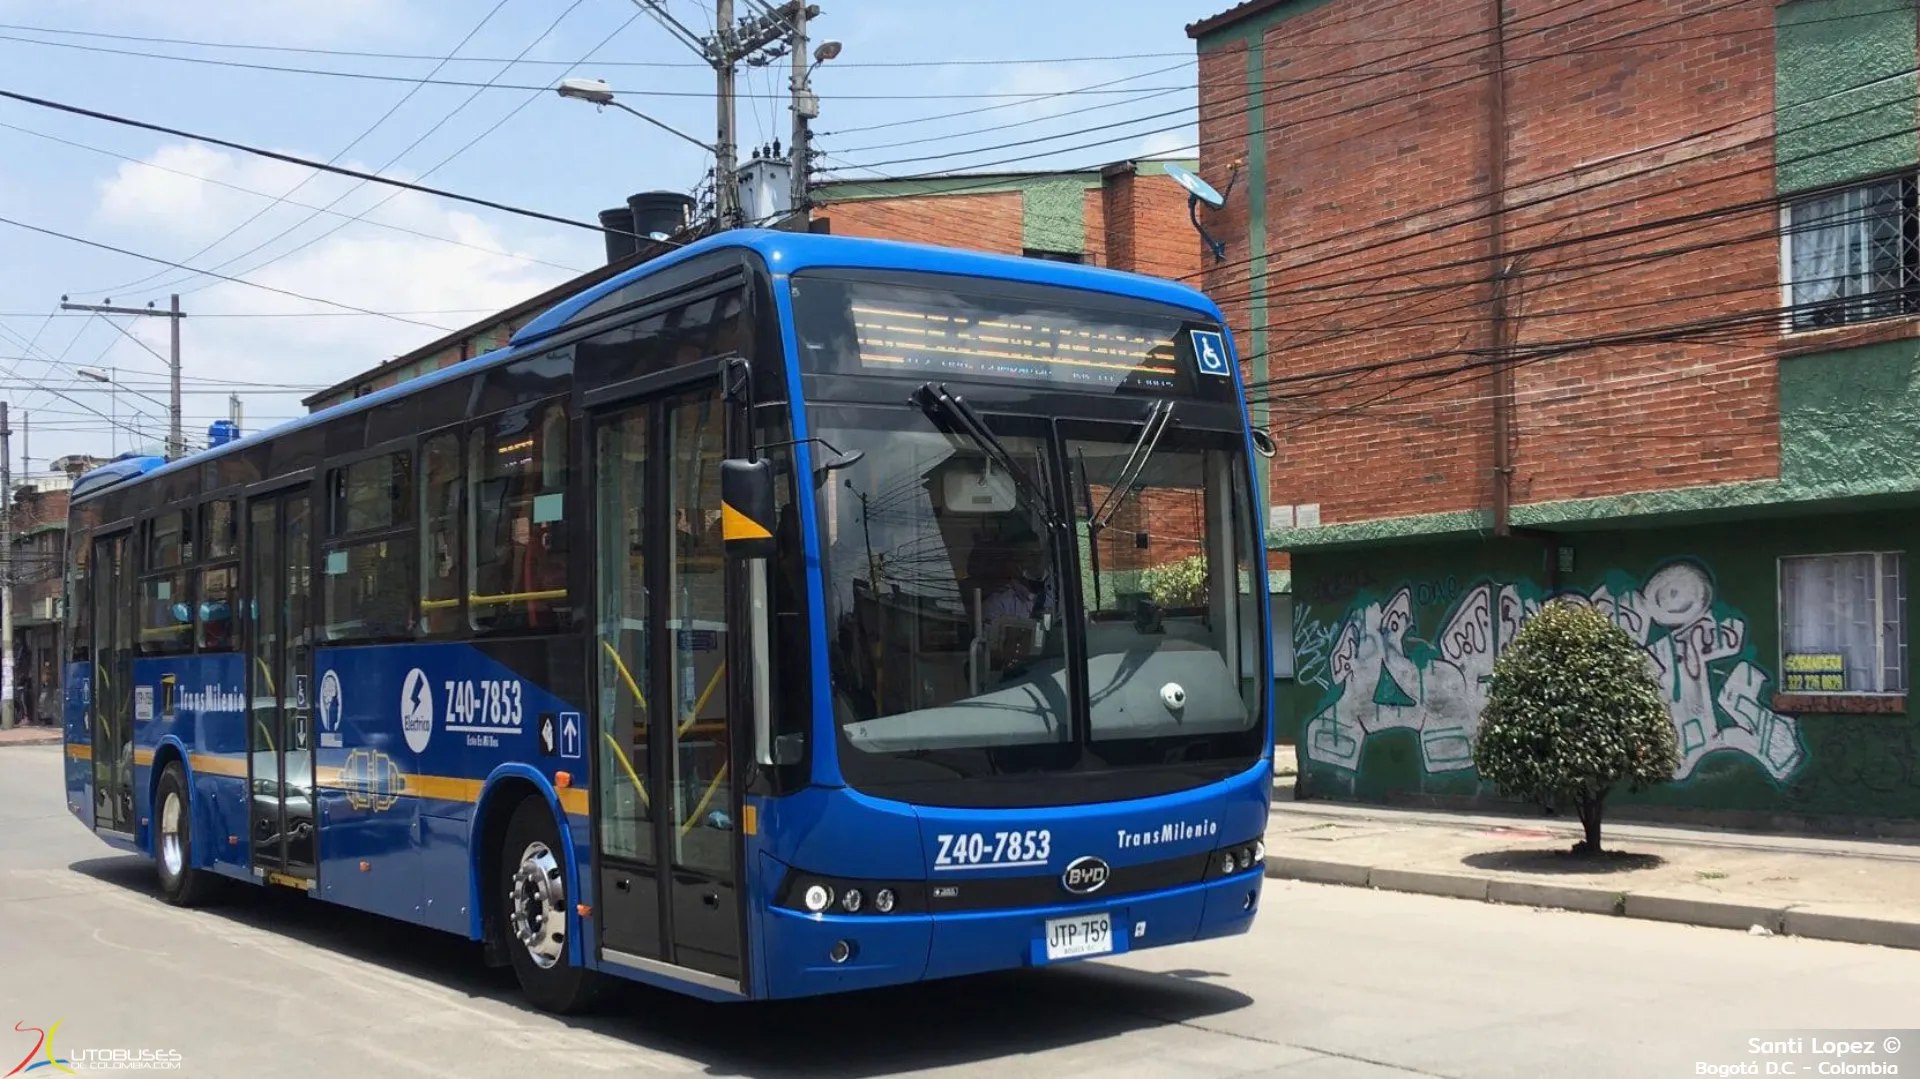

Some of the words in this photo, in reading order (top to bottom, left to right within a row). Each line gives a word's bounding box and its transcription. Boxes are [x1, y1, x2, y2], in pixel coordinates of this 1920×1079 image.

[180, 684, 246, 713] TransMilenio
[445, 680, 522, 725] Z40-7853
[935, 829, 1051, 865] Z40-7853
[1117, 819, 1217, 849] TransMilenio
[1068, 867, 1105, 885] BYD
[1050, 924, 1077, 948] JTP
[1081, 919, 1108, 944] 759
